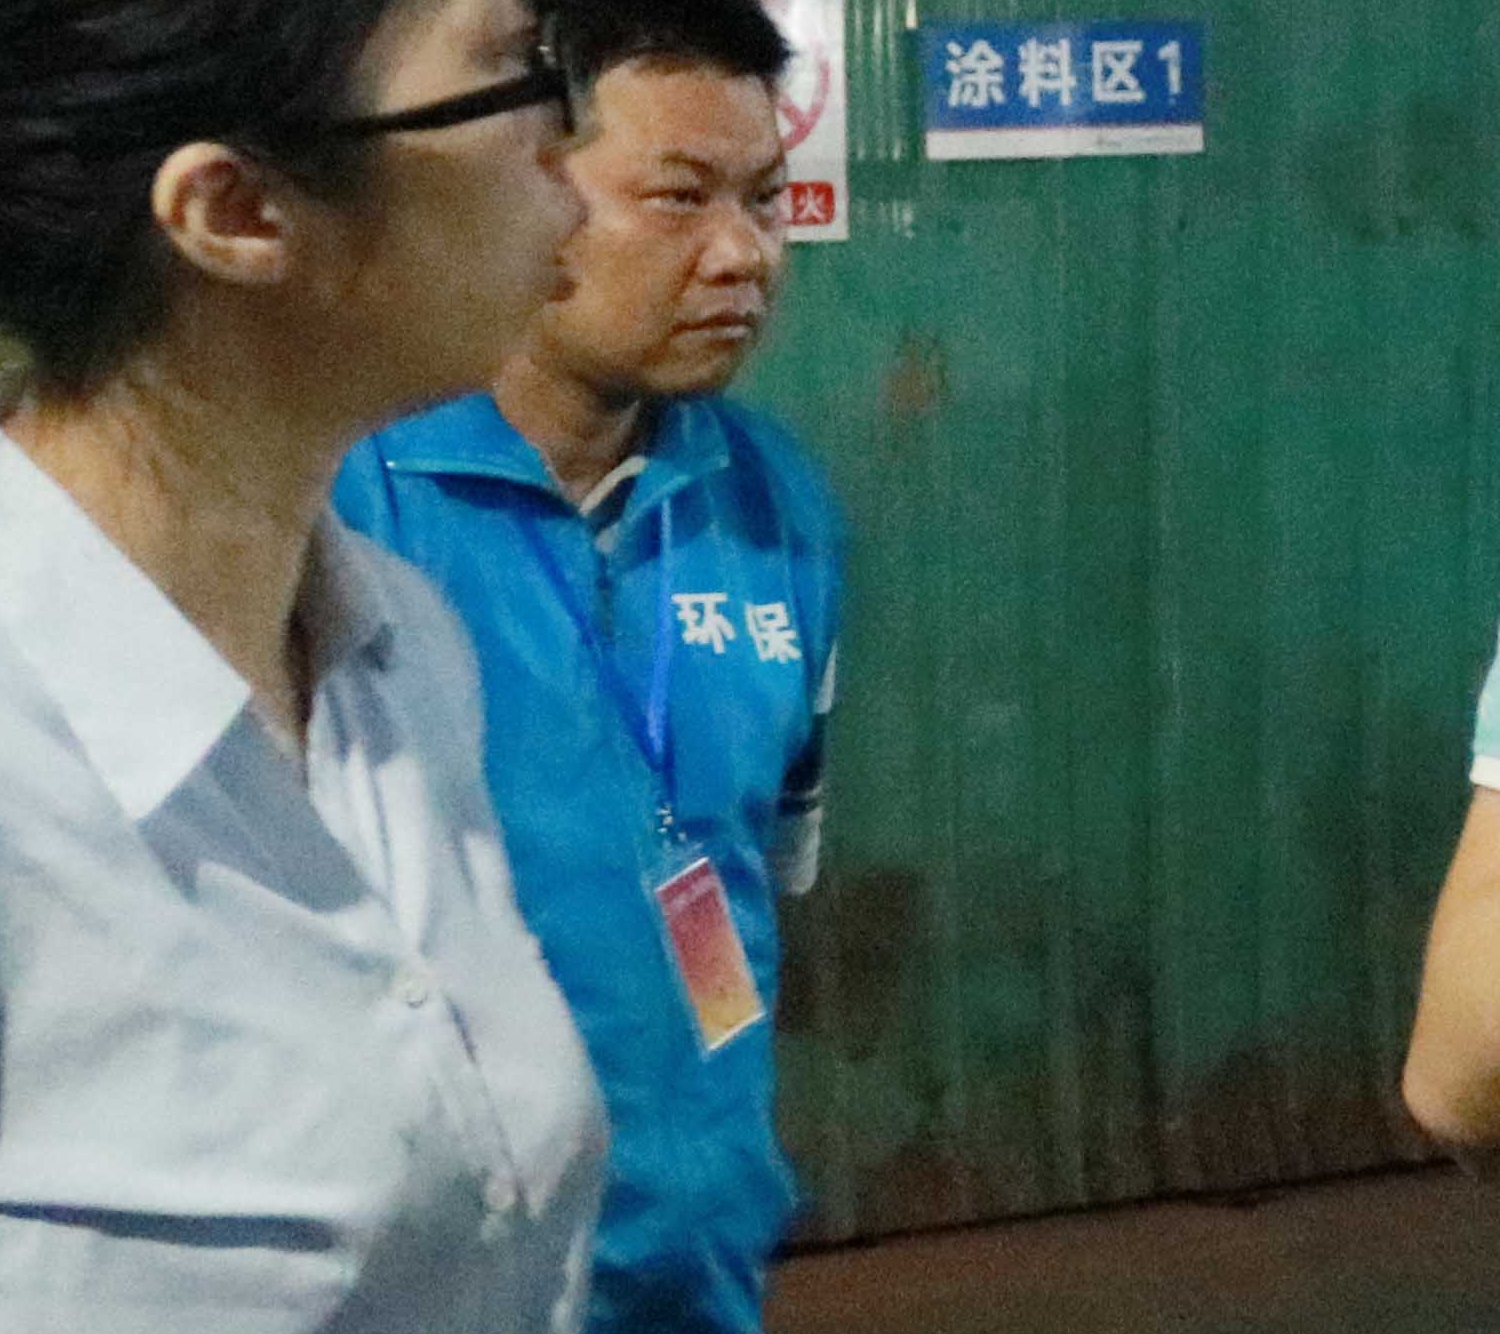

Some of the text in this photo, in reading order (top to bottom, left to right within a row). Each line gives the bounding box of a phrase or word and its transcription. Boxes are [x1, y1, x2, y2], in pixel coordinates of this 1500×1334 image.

[945, 37, 1184, 109] 涂料区1
[670, 592, 802, 665] 环保
